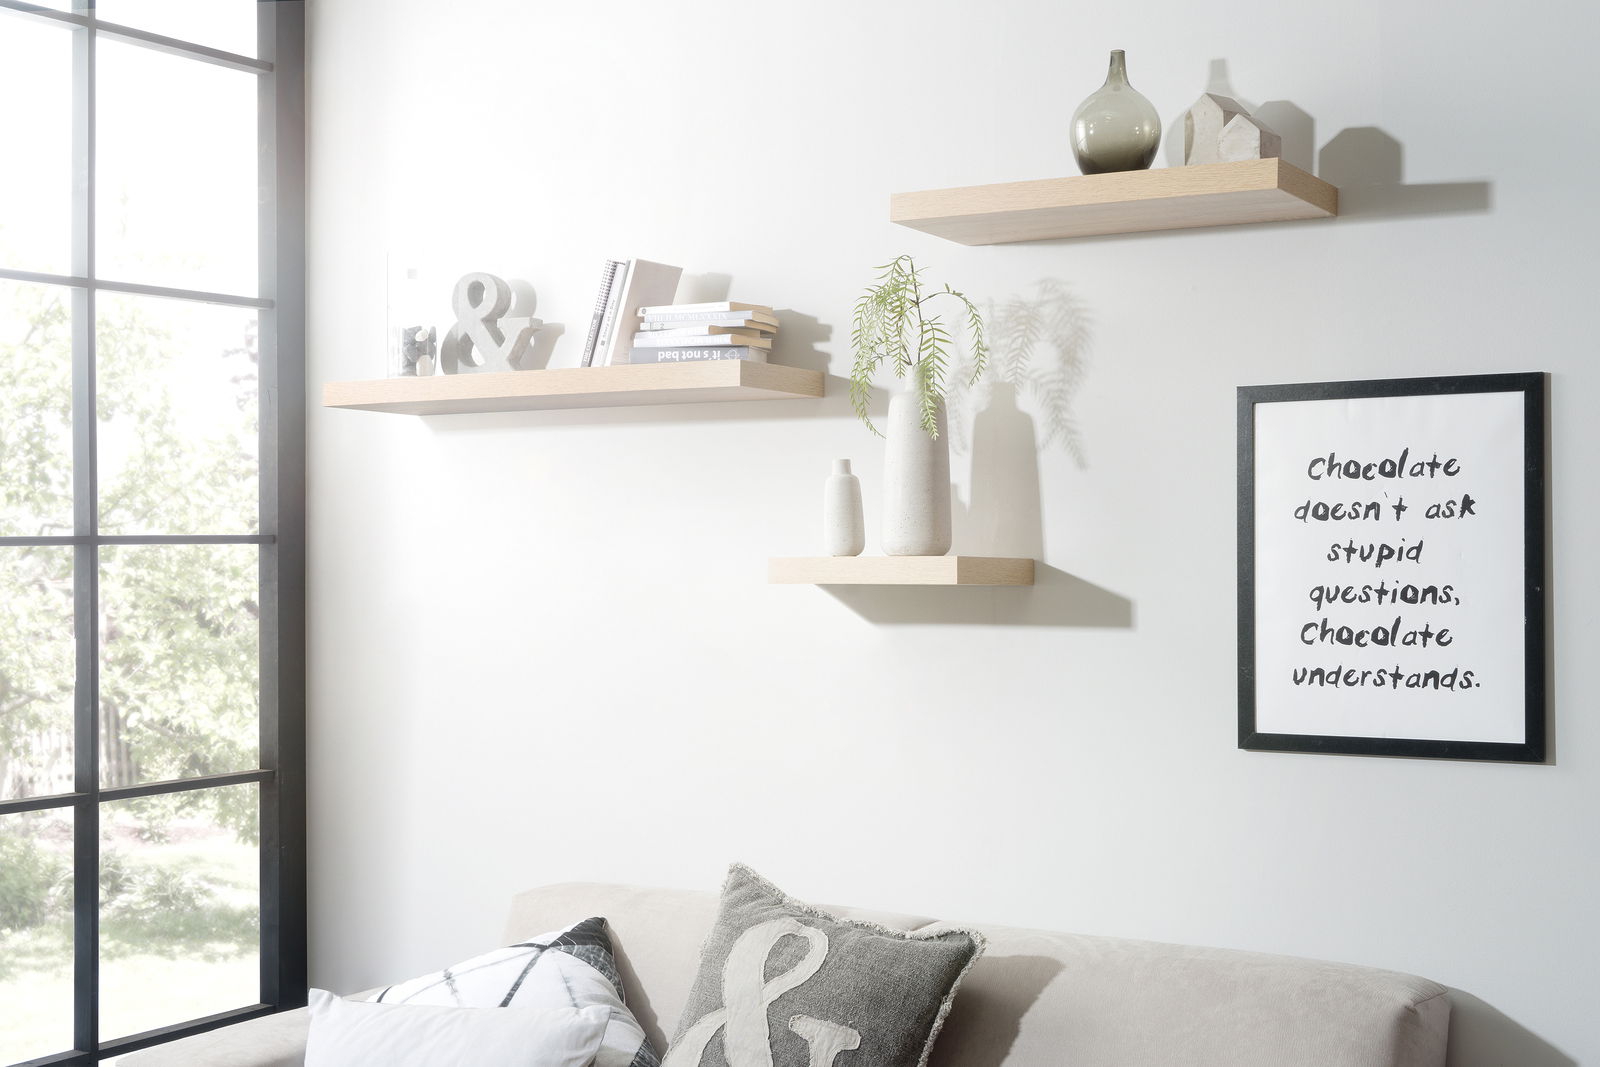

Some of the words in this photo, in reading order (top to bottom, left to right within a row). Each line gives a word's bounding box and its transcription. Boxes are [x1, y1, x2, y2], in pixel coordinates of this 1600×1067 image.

[658, 350, 679, 362] bad
[681, 350, 700, 361] not
[1294, 492, 1409, 523] doesn't
[1425, 494, 1476, 520] ask
[1327, 538, 1424, 568] stupid
[1309, 580, 1460, 612] questions,
[1293, 665, 1481, 692] understands.
